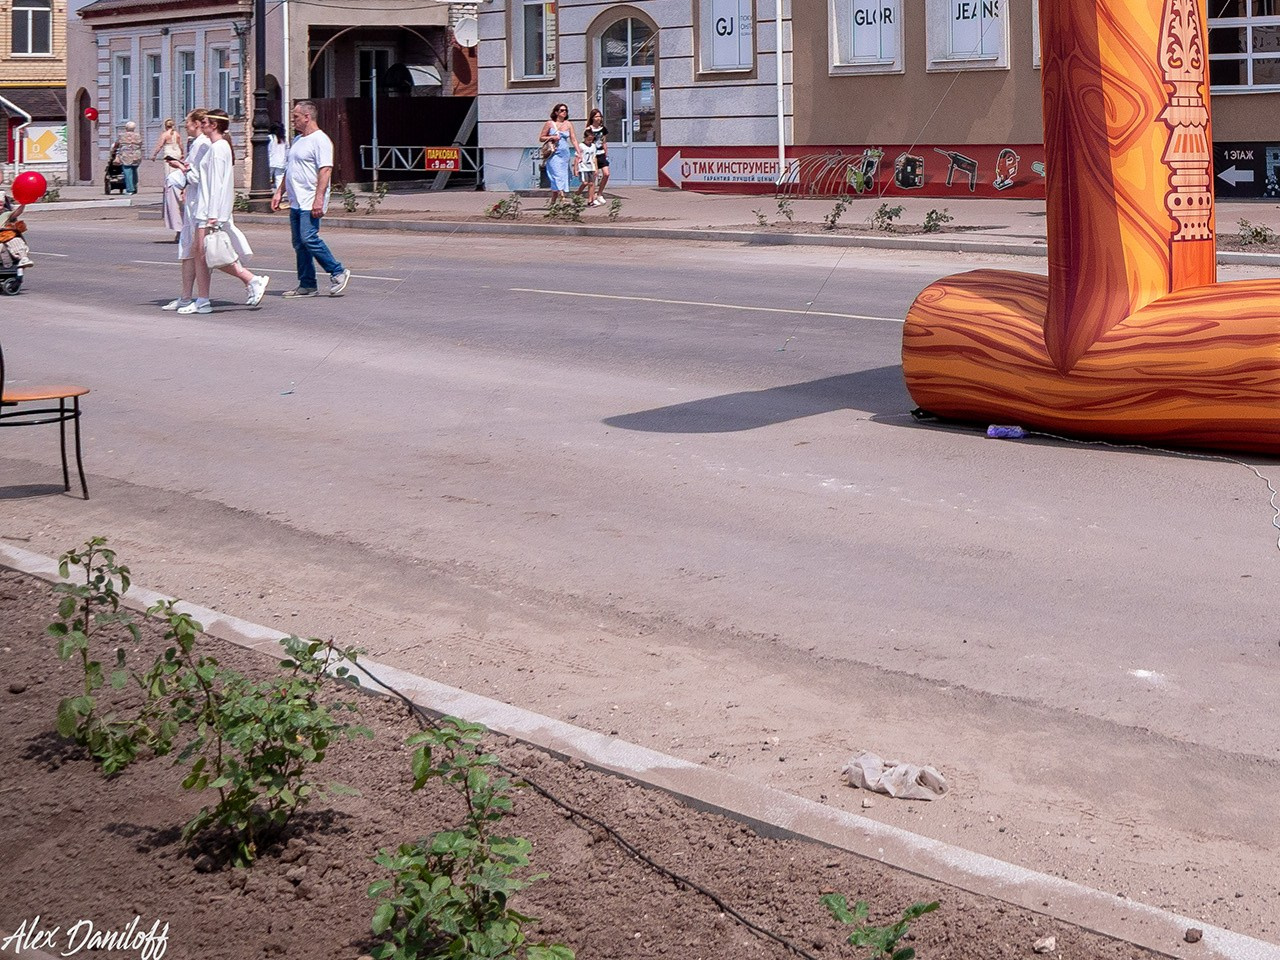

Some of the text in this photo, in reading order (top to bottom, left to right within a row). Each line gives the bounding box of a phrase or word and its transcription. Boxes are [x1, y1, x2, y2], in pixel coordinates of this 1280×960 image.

[715, 16, 734, 36] GJ
[427, 149, 458, 159] ПАРКОВКА
[1230, 150, 1254, 160] ЭТАЖ
[693, 161, 715, 174] ТМК
